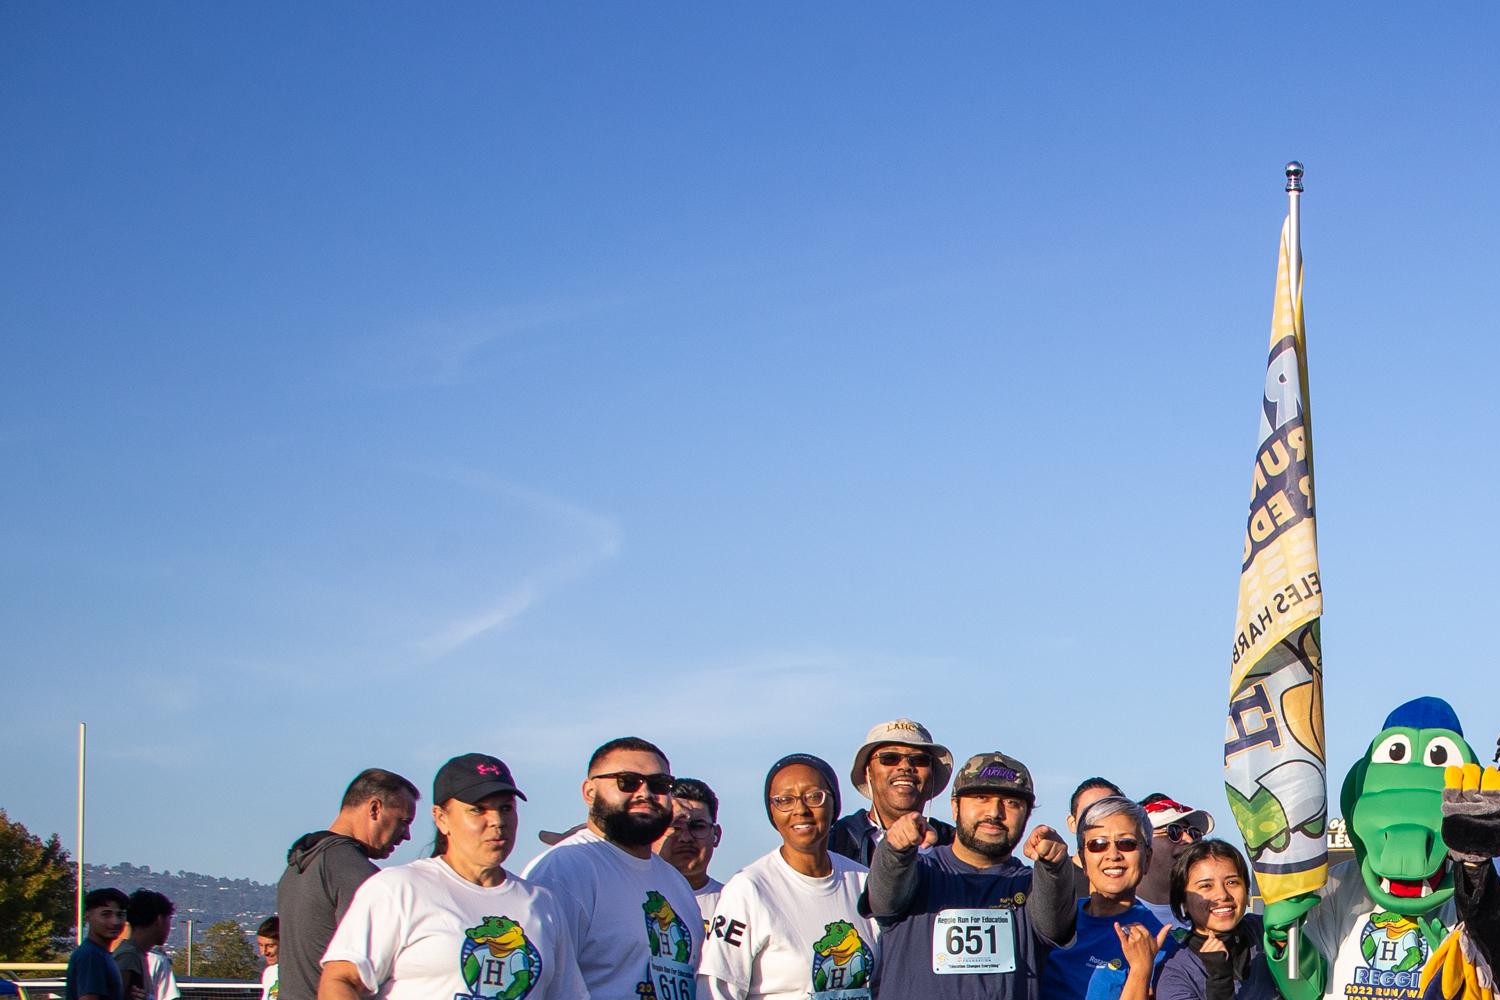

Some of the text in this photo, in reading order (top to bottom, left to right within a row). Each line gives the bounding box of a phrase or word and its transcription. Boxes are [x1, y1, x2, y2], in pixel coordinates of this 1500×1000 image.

[886, 722, 917, 732] LAHC
[978, 765, 1016, 781] LAKERS
[1327, 833, 1353, 848] LES
[937, 916, 1009, 925] Reggie Run For Education
[660, 932, 673, 956] H
[945, 925, 997, 956] 651
[1380, 940, 1399, 961] H
[482, 958, 505, 987] H
[829, 966, 847, 990] H
[1355, 967, 1421, 989] REGGI
[639, 982, 653, 994] 20
[1345, 985, 1424, 999] 2022 RUN/WA
